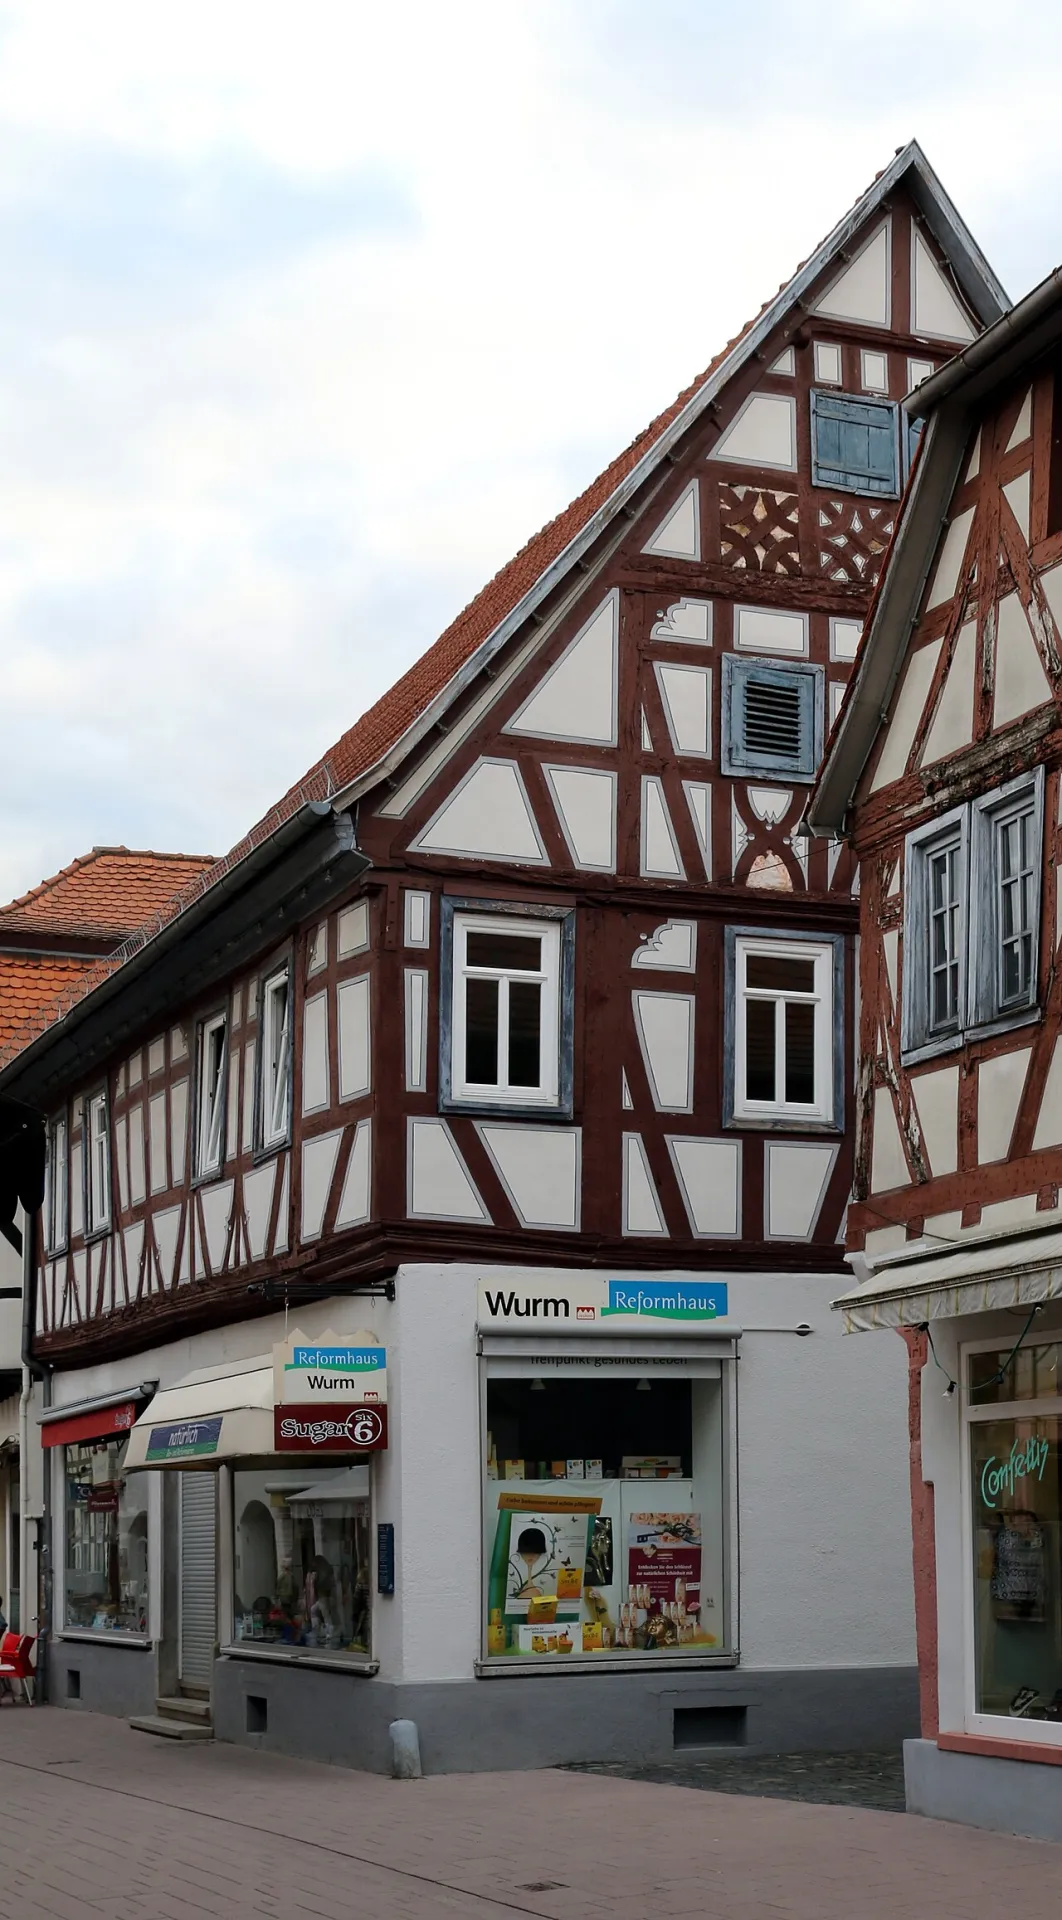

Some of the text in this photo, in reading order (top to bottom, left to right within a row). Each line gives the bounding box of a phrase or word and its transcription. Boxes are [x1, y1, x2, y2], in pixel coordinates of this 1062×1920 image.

[485, 1291, 570, 1317] Wurm
[615, 1291, 717, 1314] Reformhaus
[299, 1351, 378, 1369] Reformhaus
[307, 1375, 355, 1389] Wurm
[281, 1418, 373, 1444] Sugar 6
